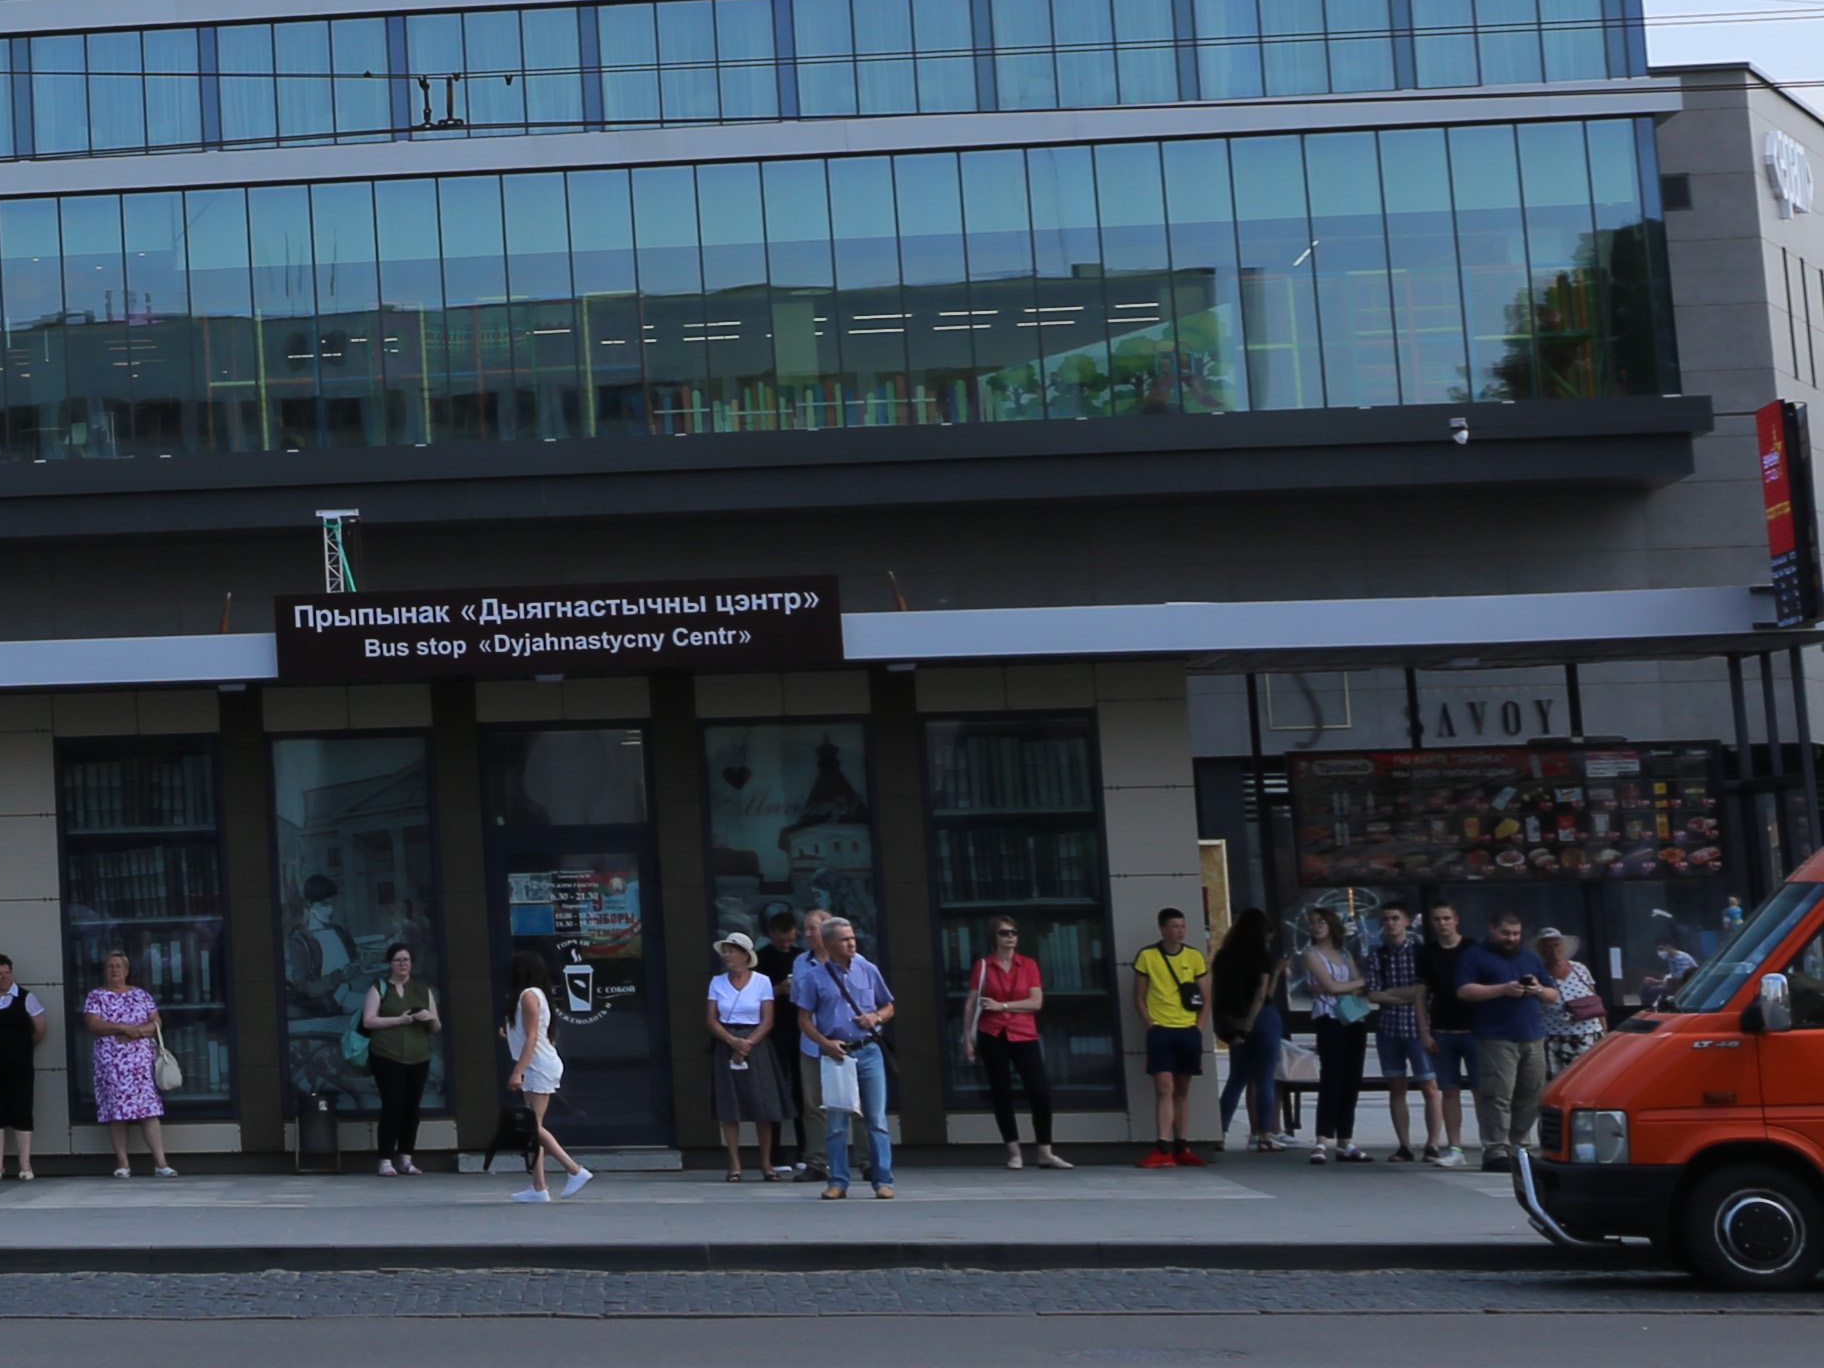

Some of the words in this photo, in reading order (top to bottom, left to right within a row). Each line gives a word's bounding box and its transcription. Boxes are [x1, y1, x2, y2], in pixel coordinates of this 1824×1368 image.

[294, 598, 451, 631] Прыпынак
[461, 591, 707, 624] «Дыягнастычны
[716, 586, 819, 618] цэнтр»
[364, 638, 409, 657] Bus
[415, 635, 467, 660] stop
[479, 629, 664, 657] «Dyjahnastycny
[672, 626, 751, 647] Centr»
